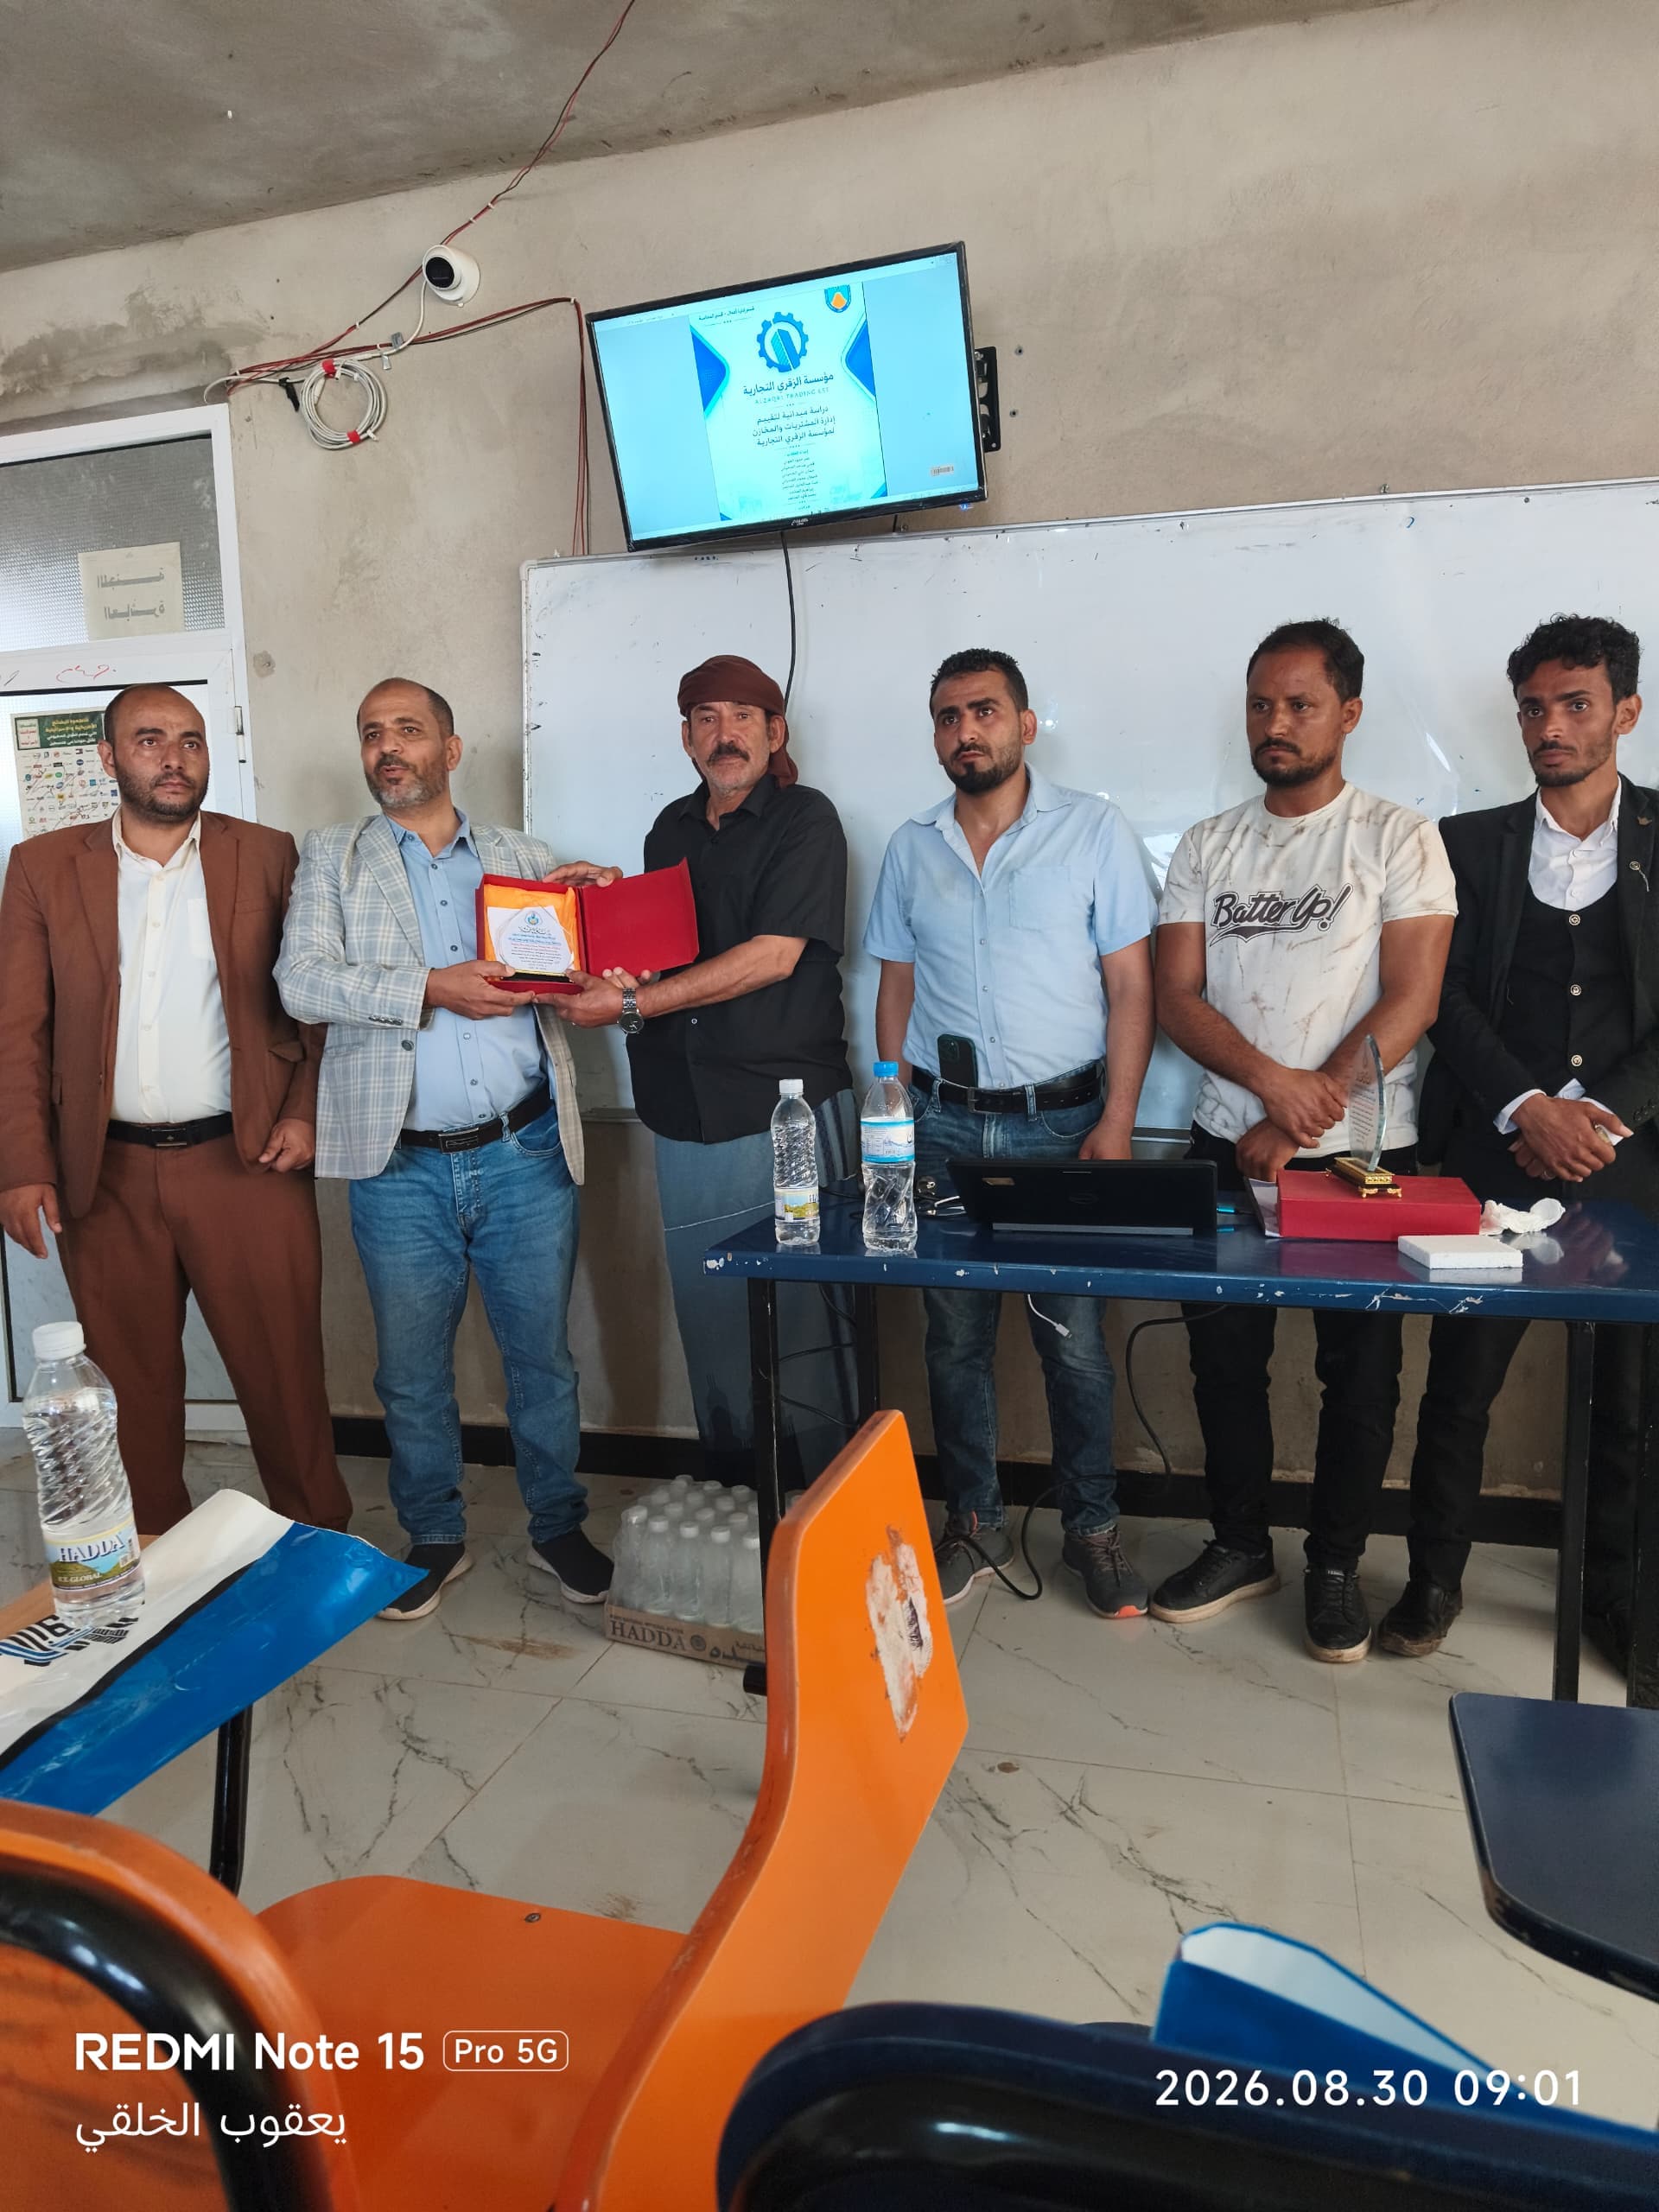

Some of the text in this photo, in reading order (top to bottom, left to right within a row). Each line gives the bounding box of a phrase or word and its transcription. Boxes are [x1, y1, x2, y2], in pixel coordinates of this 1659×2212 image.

[743, 371, 834, 397] مؤسسة الزقري التجارية
[785, 388, 816, 399] TRADING
[757, 405, 829, 426] دراسة ميدانية لتقييم
[753, 416, 836, 437] إدارة المشتريات والمخازن
[757, 427, 835, 447] لمؤسسة الزقري التجارية
[59, 1535, 125, 1562] HADDA
[609, 1619, 686, 1651] HADDA
